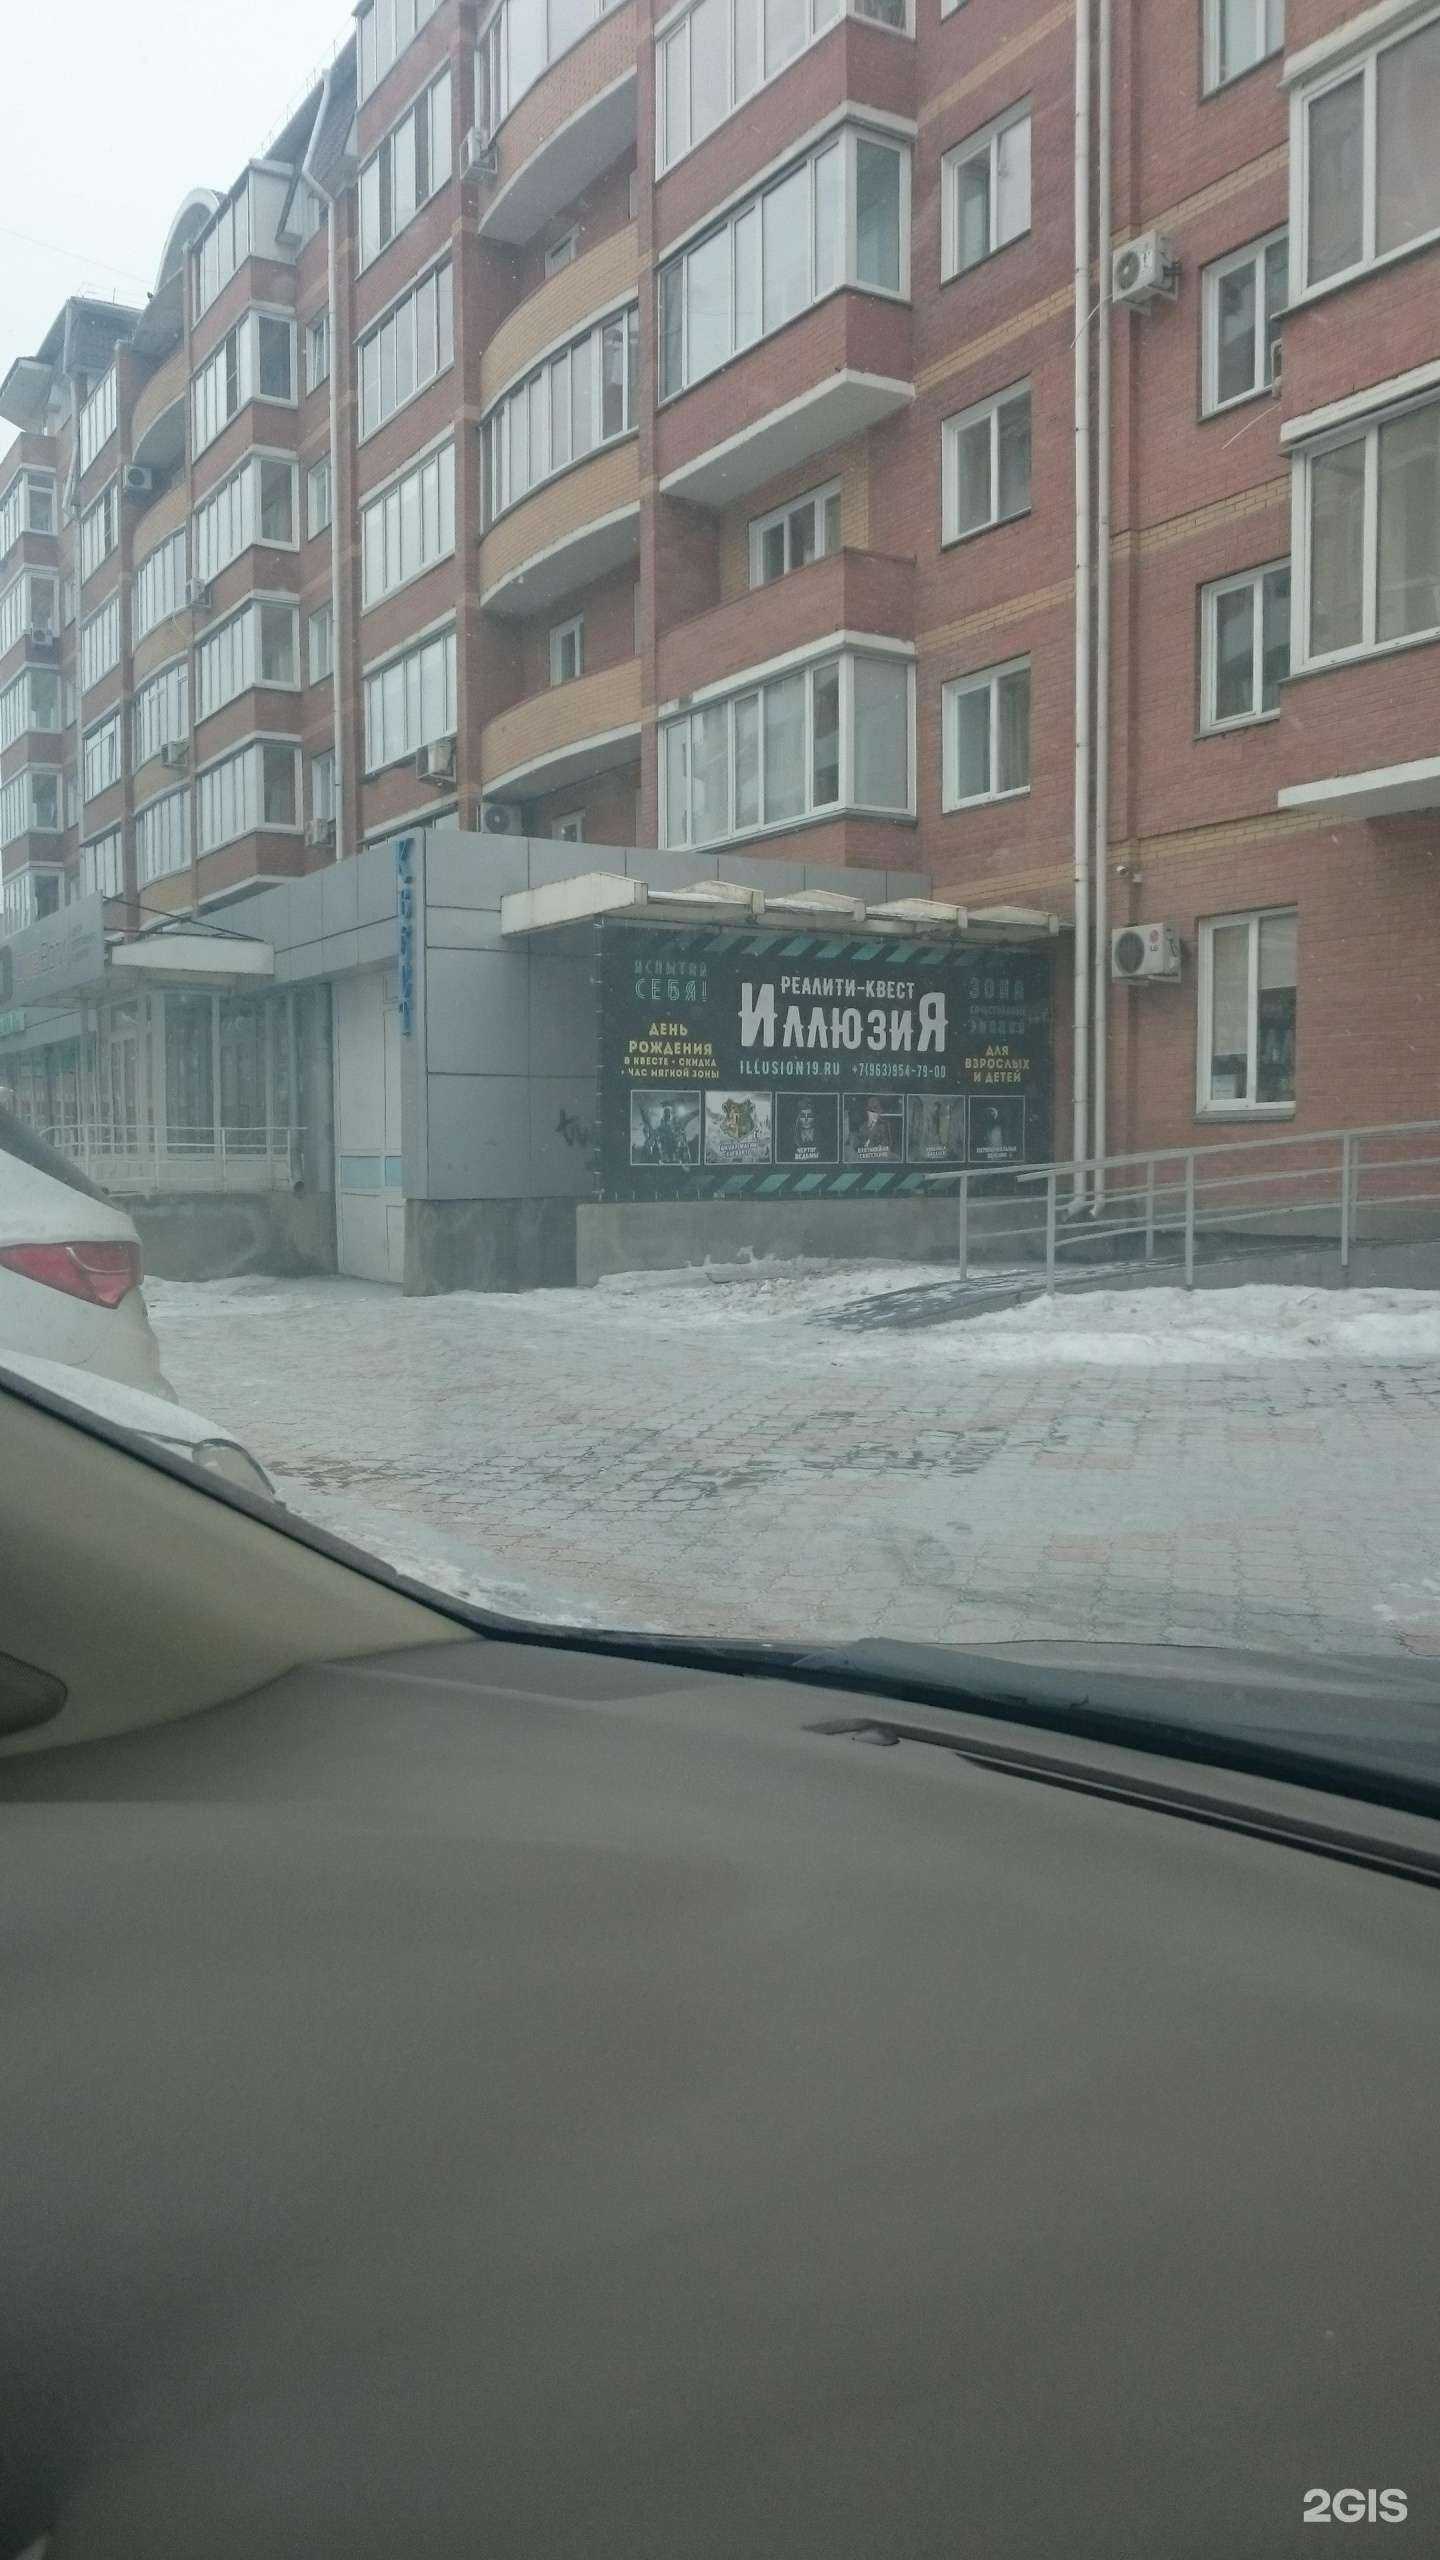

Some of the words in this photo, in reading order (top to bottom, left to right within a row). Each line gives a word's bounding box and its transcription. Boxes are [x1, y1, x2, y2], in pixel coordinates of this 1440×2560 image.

[635, 978, 708, 1002] СЕБЯ!
[781, 975, 915, 999] РЕАЛИТИ-КВЕСТ
[737, 982, 949, 1052] ИЛЛЮЗИЯ
[648, 1022, 688, 1037] ДЕНЬ
[628, 1040, 713, 1055] РОЖДЕНИЯ
[985, 1044, 1009, 1057] ДЛЯ
[624, 1056, 630, 1065] В
[633, 1056, 669, 1066] КВЕСТЕ
[678, 1058, 717, 1067] СКИДКА
[739, 1059, 841, 1076] ILLUSION19.RU
[964, 1057, 1030, 1070] ВЗРОСЛЫХ
[628, 1067, 648, 1077] ЧАС
[651, 1067, 689, 1078] МЯГКОЙ
[692, 1069, 719, 1078] ЗОНЫ
[973, 1071, 981, 1083] И
[984, 1069, 1021, 1085] ДЕТЕЙ
